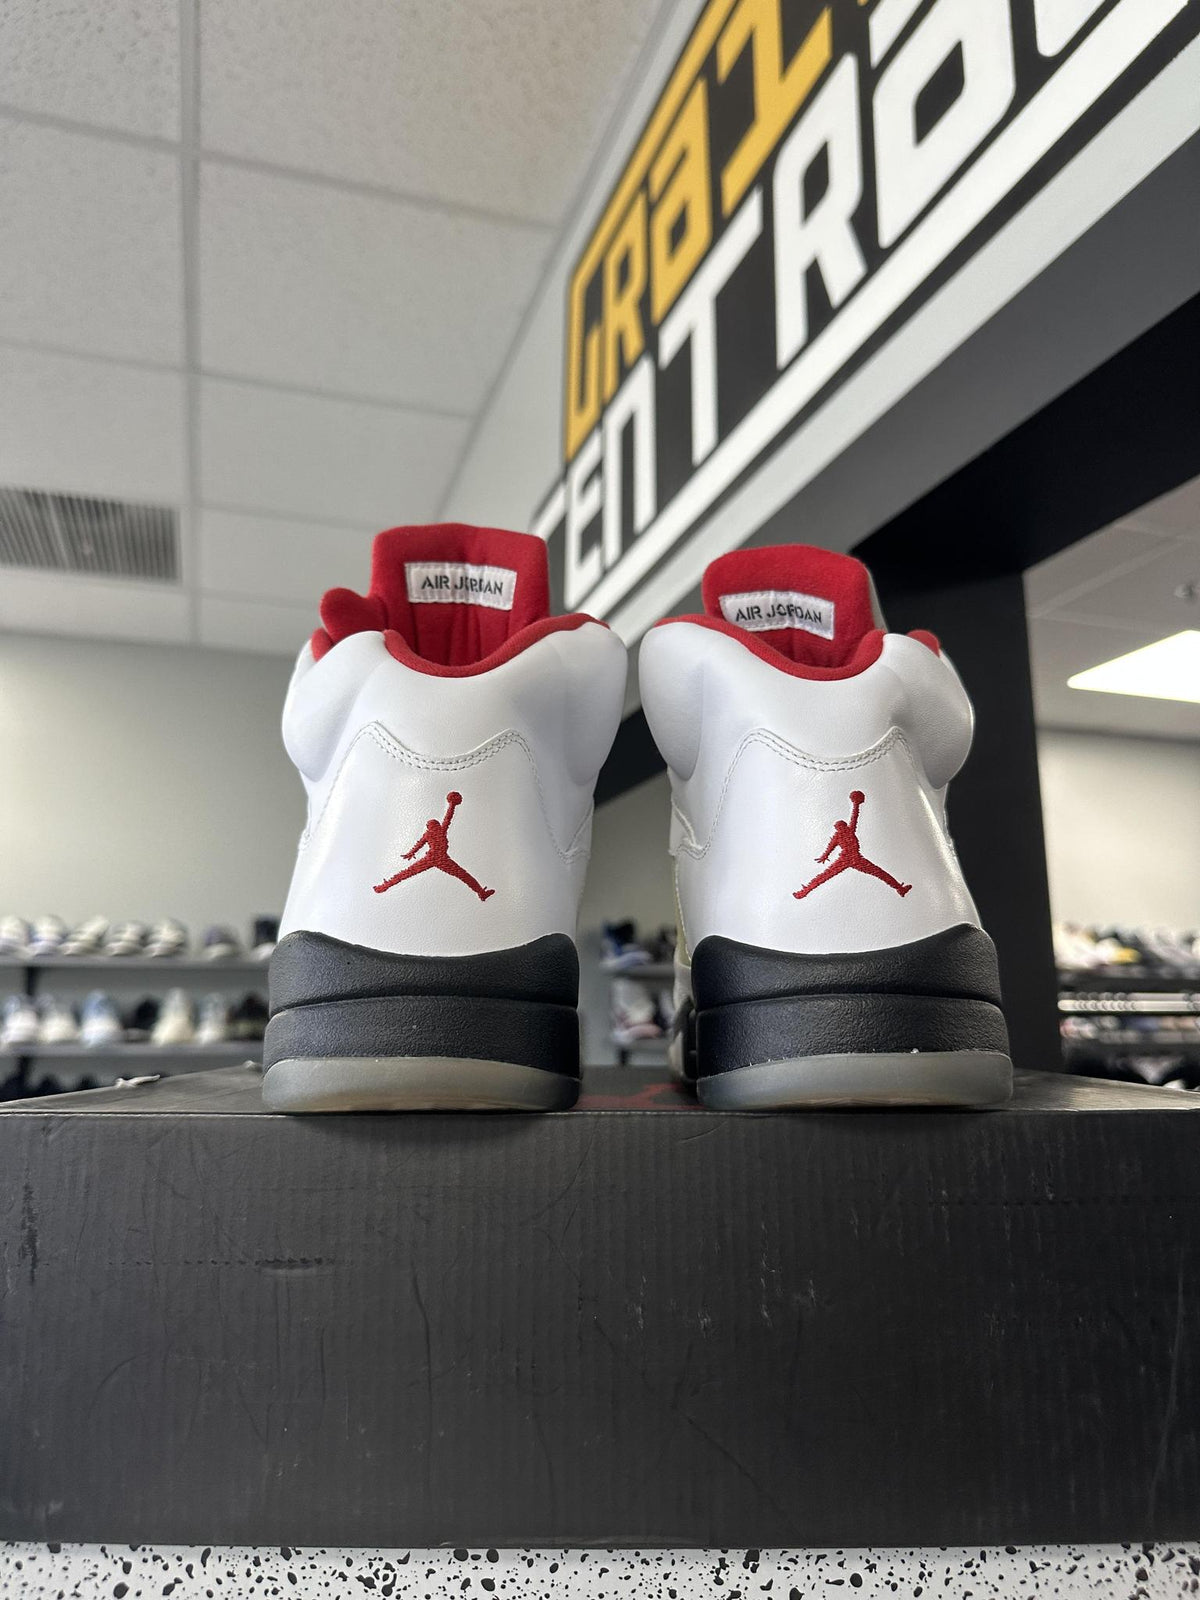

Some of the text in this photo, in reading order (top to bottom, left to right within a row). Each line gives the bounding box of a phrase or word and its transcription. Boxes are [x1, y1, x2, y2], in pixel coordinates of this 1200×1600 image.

[421, 575, 450, 590] AIR
[735, 603, 823, 624] AIR JORDAN
